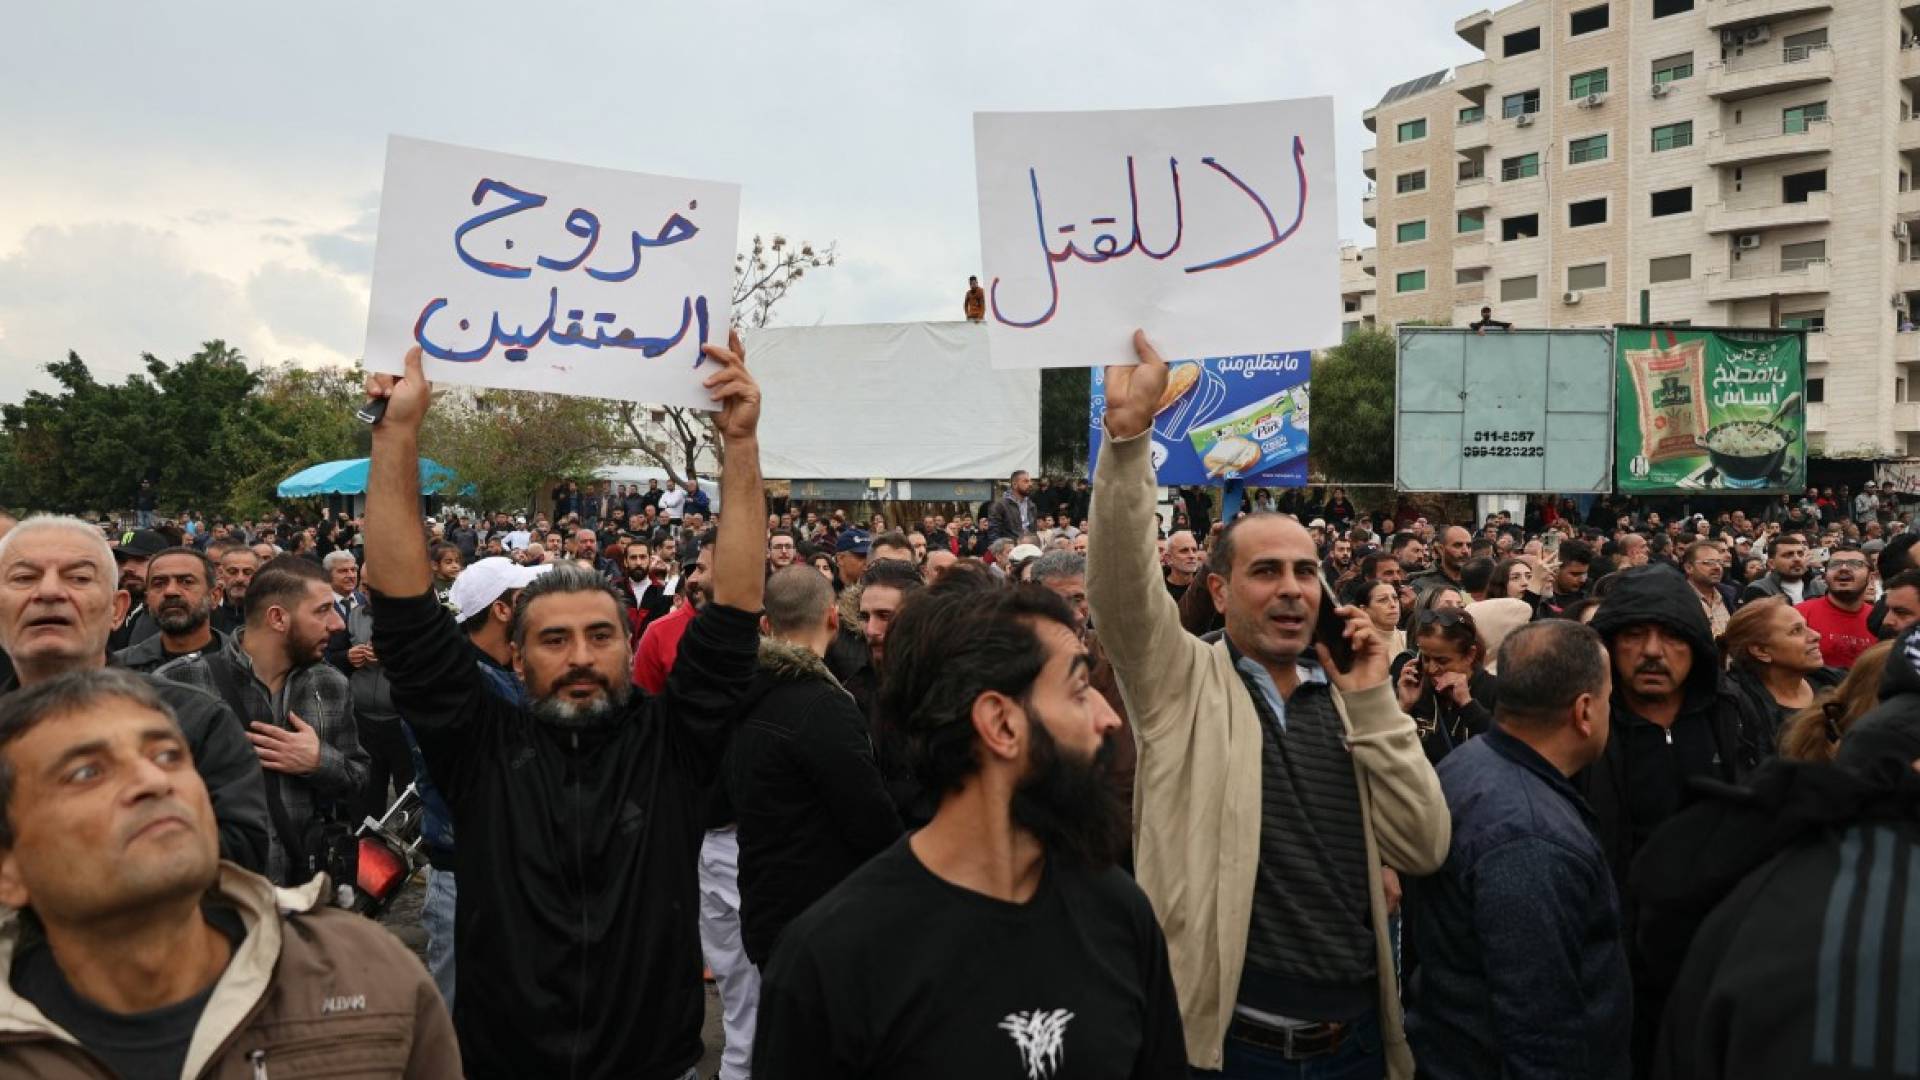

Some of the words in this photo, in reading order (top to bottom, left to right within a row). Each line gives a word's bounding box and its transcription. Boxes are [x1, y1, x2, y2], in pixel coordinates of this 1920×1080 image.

[454, 178, 699, 282] خروج
[990, 156, 1183, 328] للقتل
[1185, 135, 1308, 273] لا
